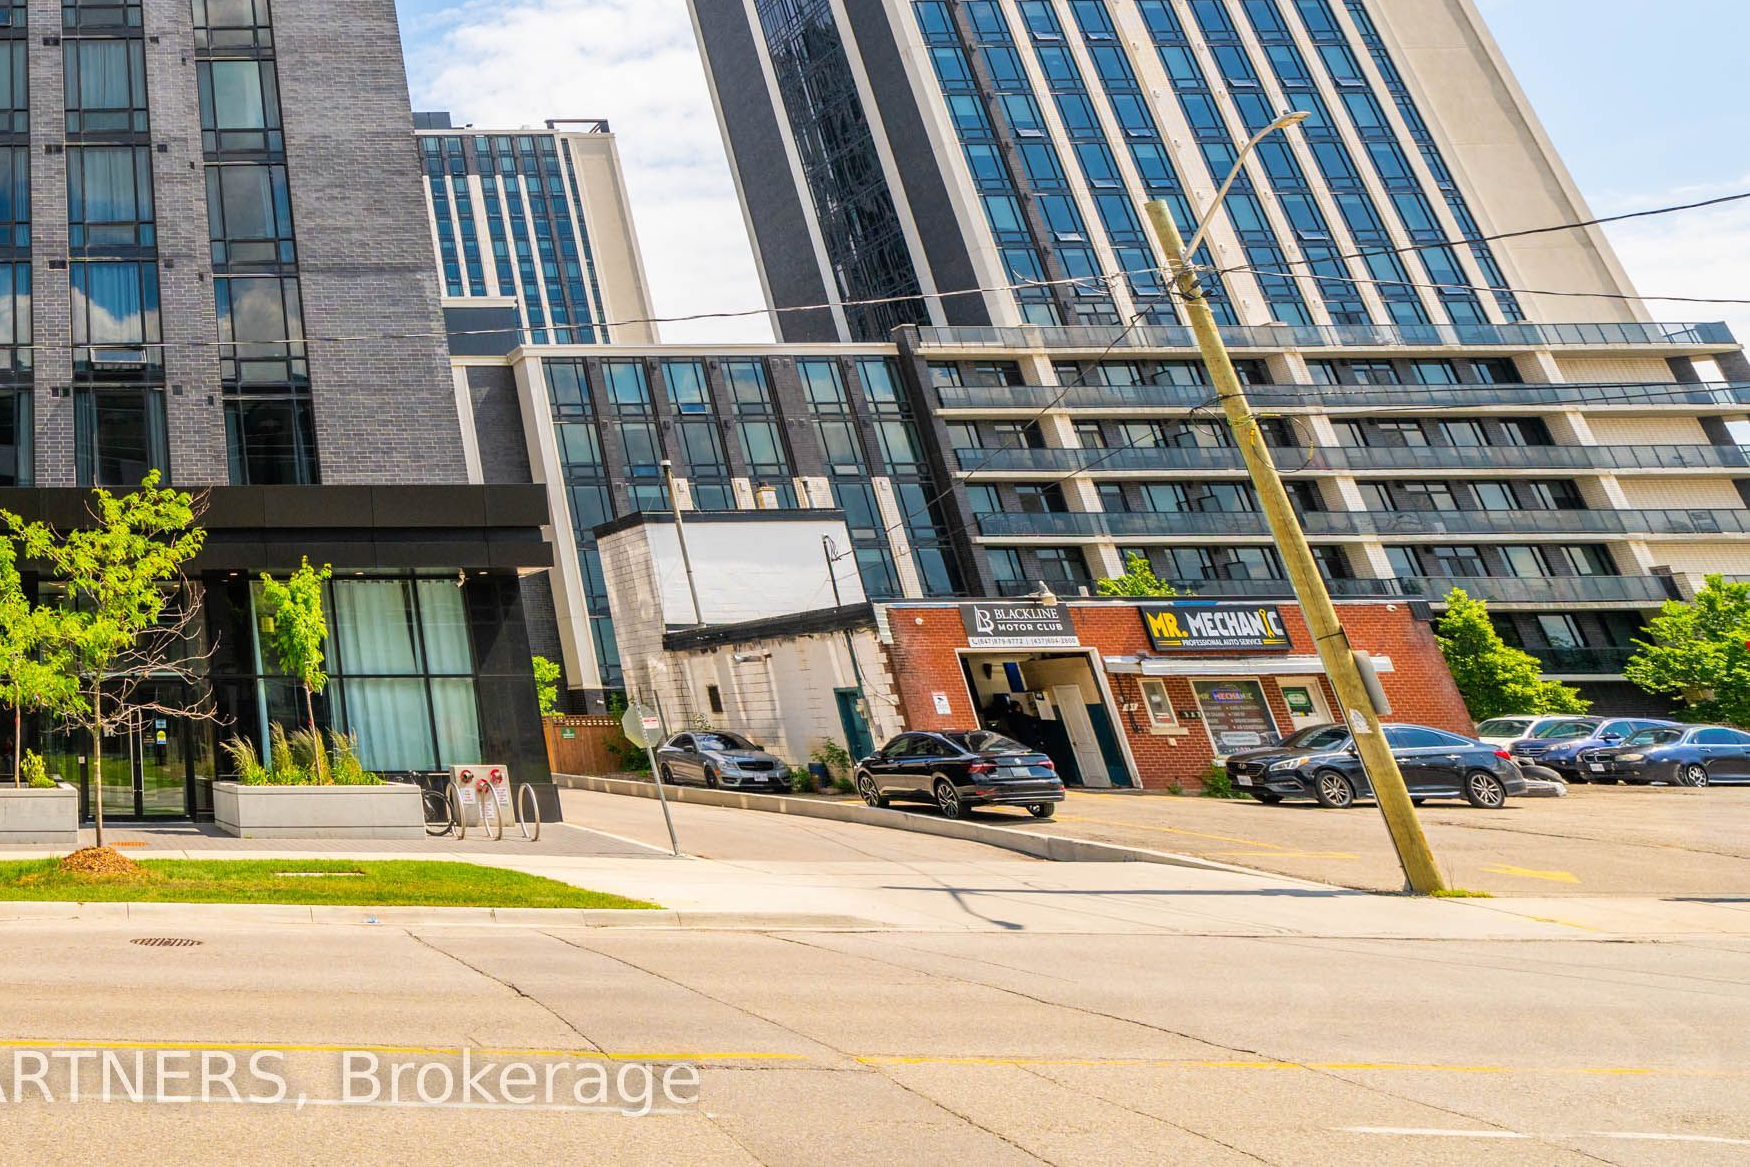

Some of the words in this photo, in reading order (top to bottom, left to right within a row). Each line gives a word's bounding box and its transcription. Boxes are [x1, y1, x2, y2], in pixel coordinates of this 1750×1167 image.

[993, 608, 1059, 620] BLACKLINE
[997, 623, 1034, 632] MOTOR
[1036, 623, 1064, 631] CLUB
[1145, 611, 1189, 638] MR.
[1184, 608, 1285, 639] MECHANIC
[1181, 638, 1224, 646] PROFESSIONAL
[1223, 638, 1240, 646] AUTO
[1239, 638, 1264, 646] SERVICE
